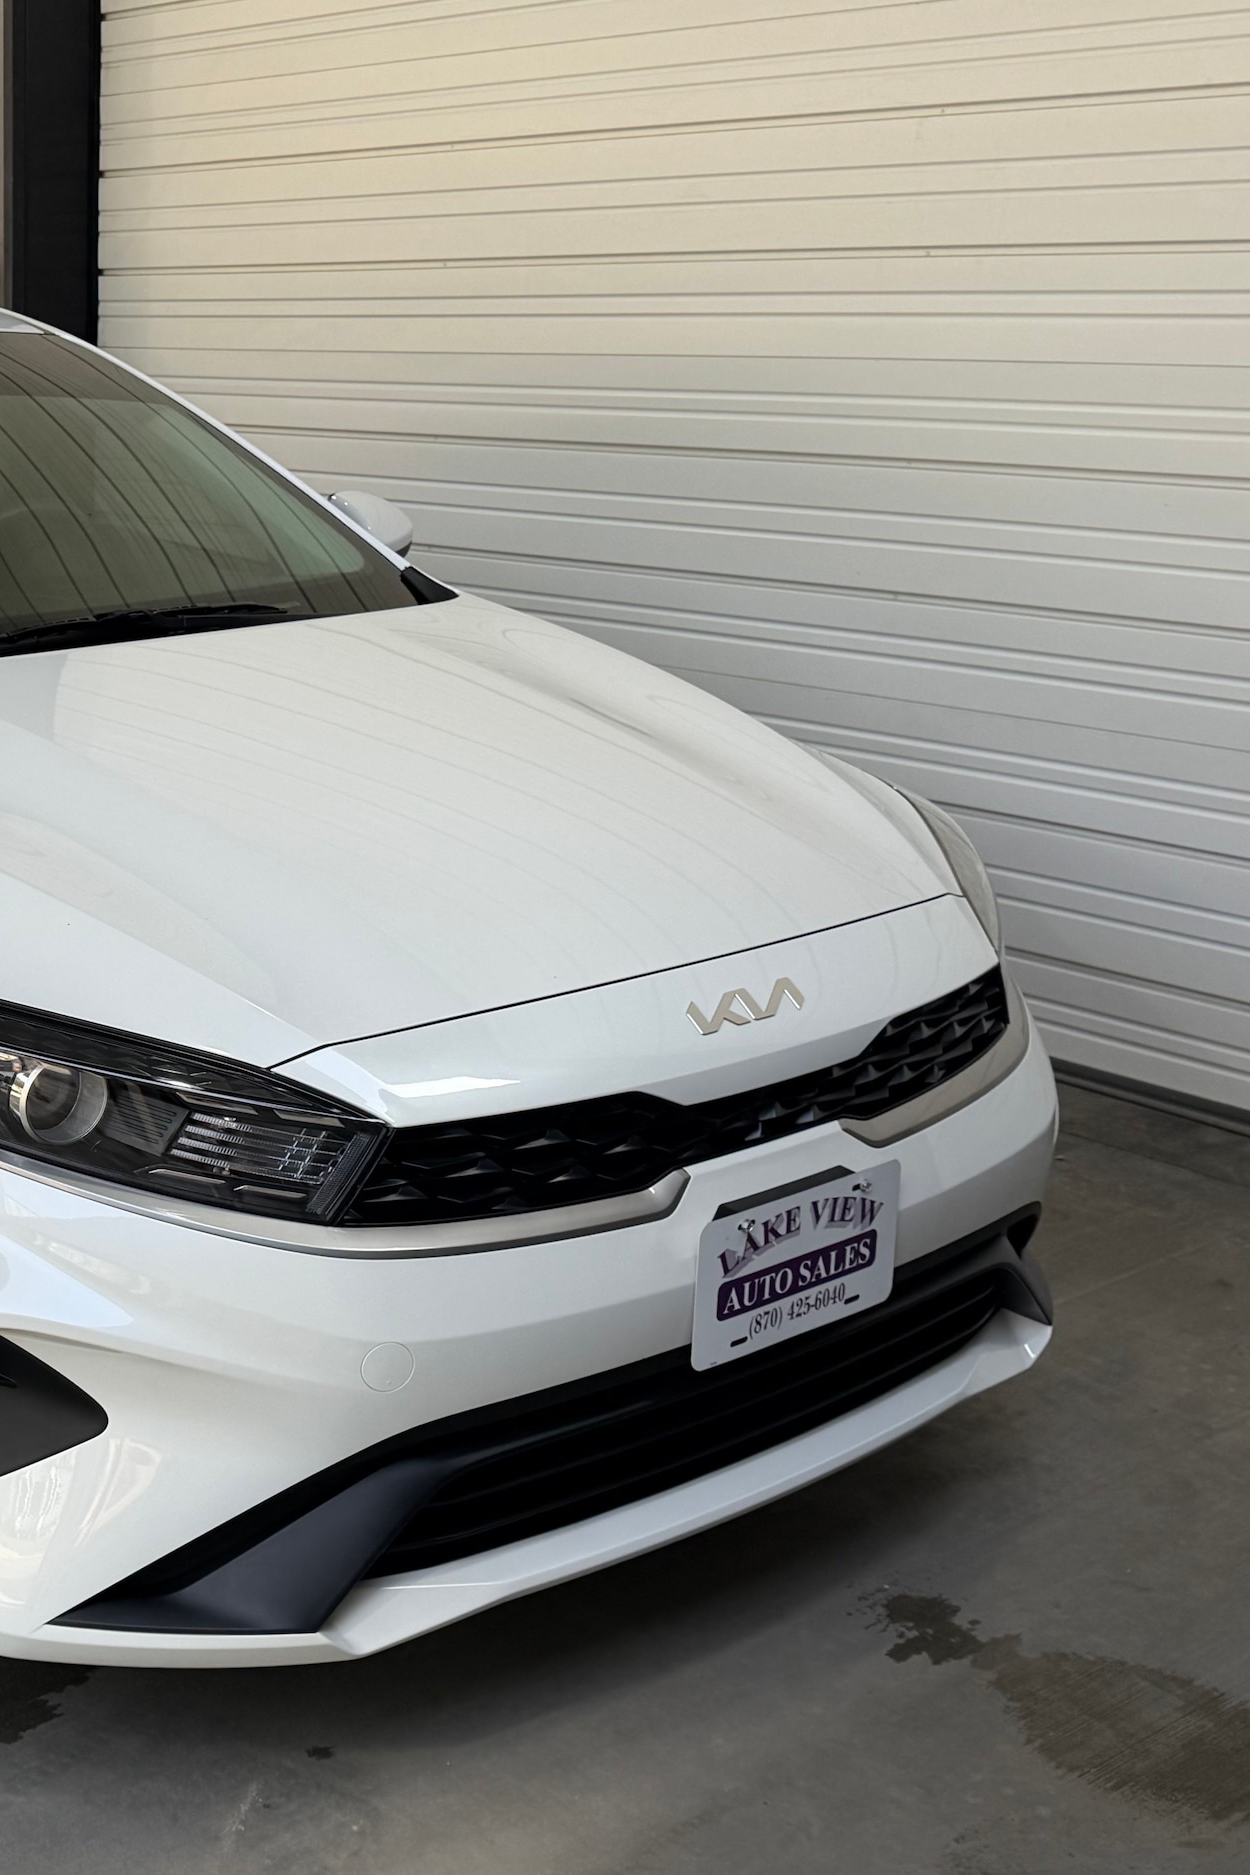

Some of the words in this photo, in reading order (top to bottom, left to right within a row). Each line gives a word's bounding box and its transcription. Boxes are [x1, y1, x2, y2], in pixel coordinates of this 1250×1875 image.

[686, 976, 805, 1036] KIA
[717, 1206, 801, 1278] LAKE
[810, 1197, 884, 1231] VIEW
[723, 1267, 793, 1315] AUTO
[798, 1238, 871, 1287] SALES
[749, 1306, 783, 1340] (870)
[787, 1282, 846, 1320] 425-6040
